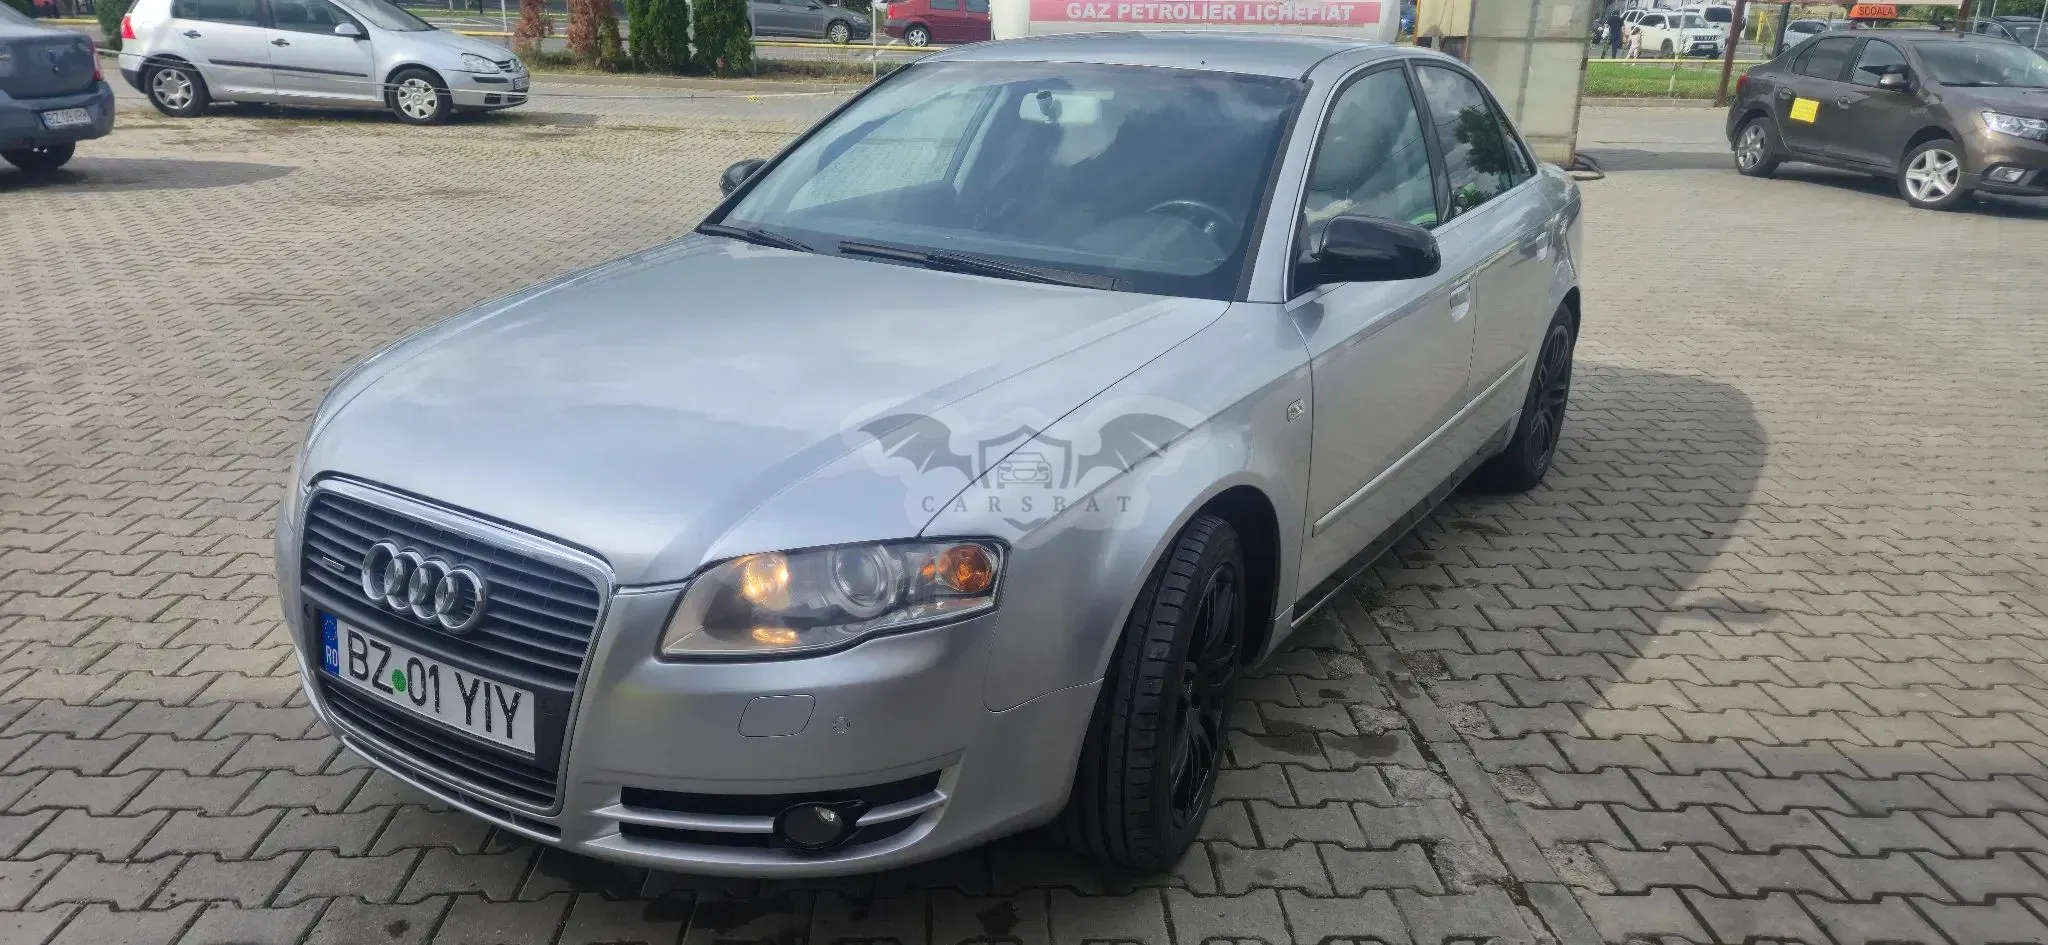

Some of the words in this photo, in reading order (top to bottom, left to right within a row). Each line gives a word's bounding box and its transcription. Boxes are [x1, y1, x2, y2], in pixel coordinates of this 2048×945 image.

[1066, 3, 1111, 18] GAZ
[1118, 3, 1237, 20] PETROLIER
[1244, 4, 1354, 21] LICHEFIAT
[1858, 6, 1893, 16] SCOALA
[325, 645, 339, 667] RO
[347, 627, 394, 695] BZ
[406, 656, 441, 714] 01
[454, 671, 522, 739] YIY
